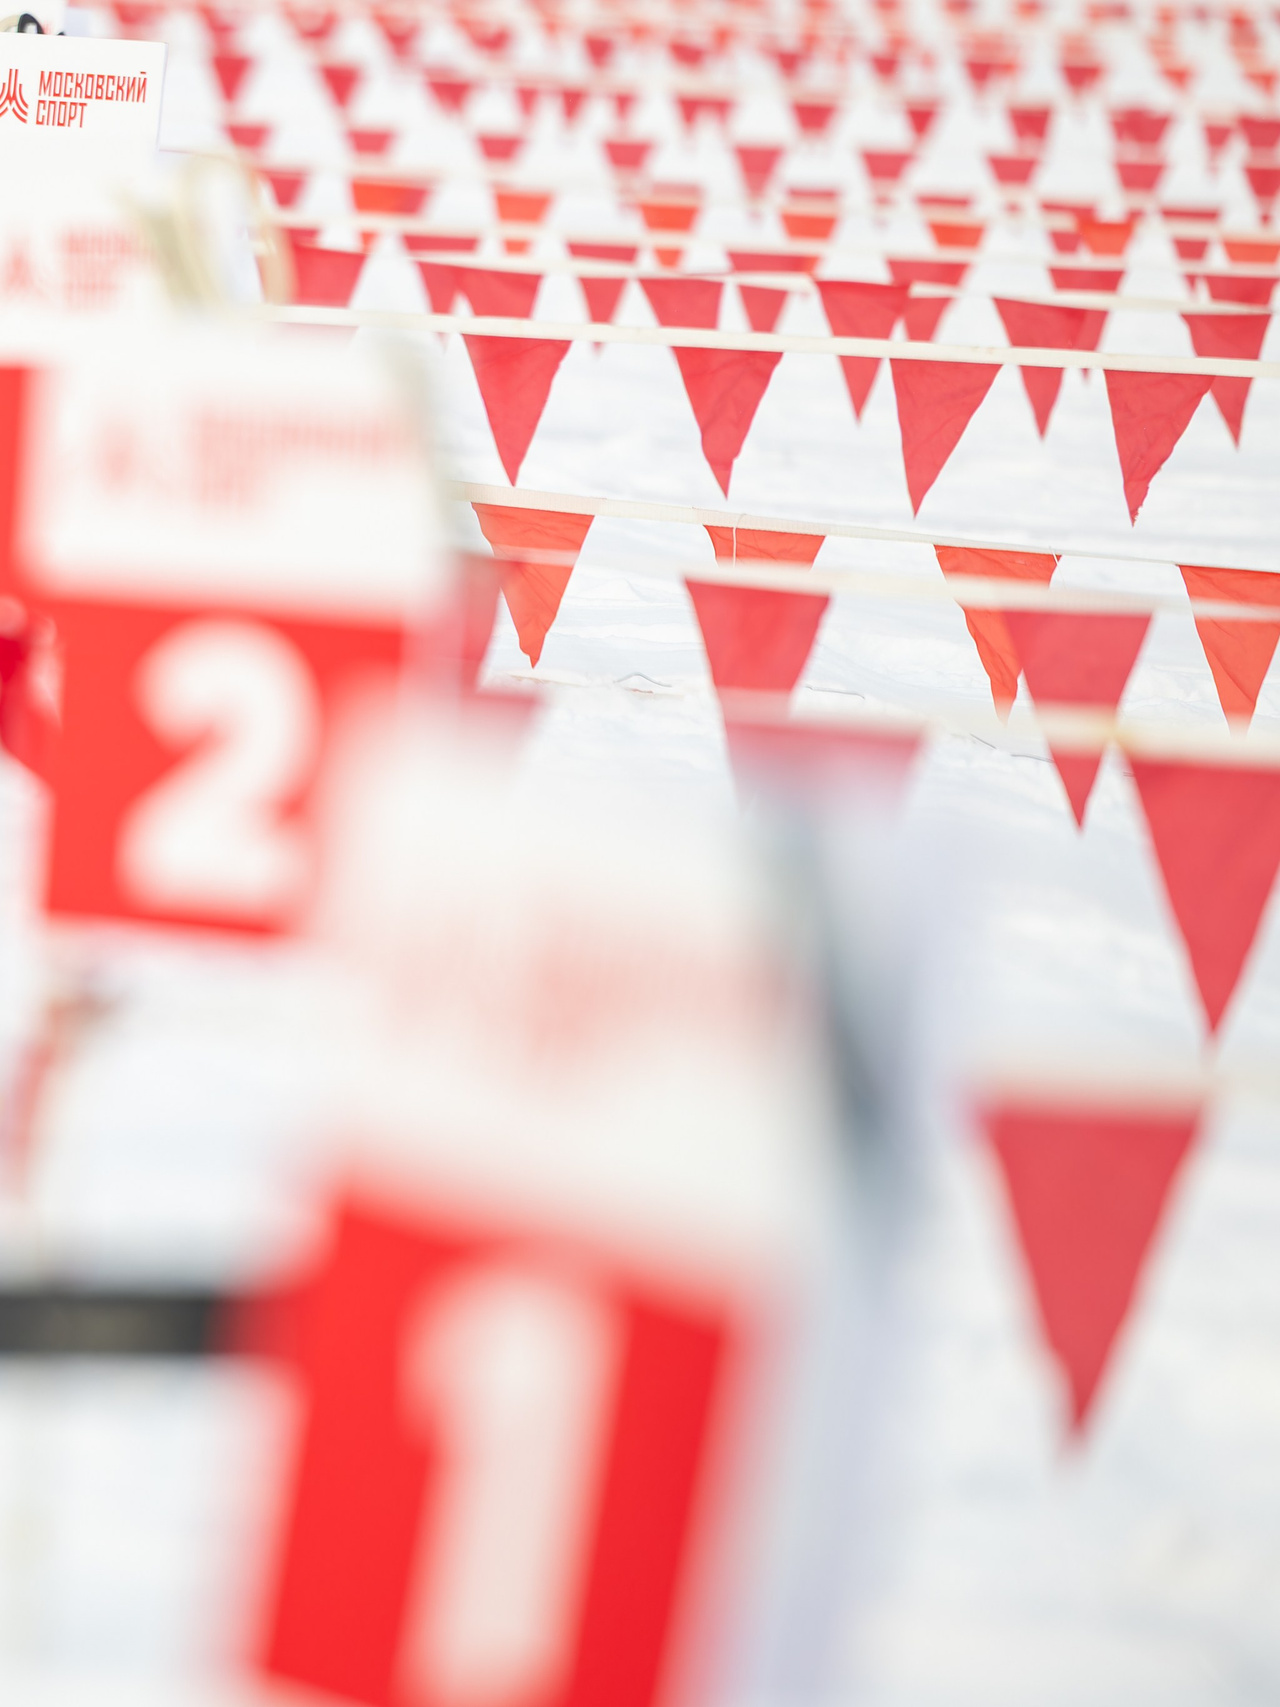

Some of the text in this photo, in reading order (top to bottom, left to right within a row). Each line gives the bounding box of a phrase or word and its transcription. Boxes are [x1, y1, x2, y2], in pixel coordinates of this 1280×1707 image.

[36, 99, 87, 128] СПОРТ
[38, 70, 147, 103] МОСКОВСКИЙ
[122, 617, 320, 905] 2
[398, 1258, 625, 1704] 1
